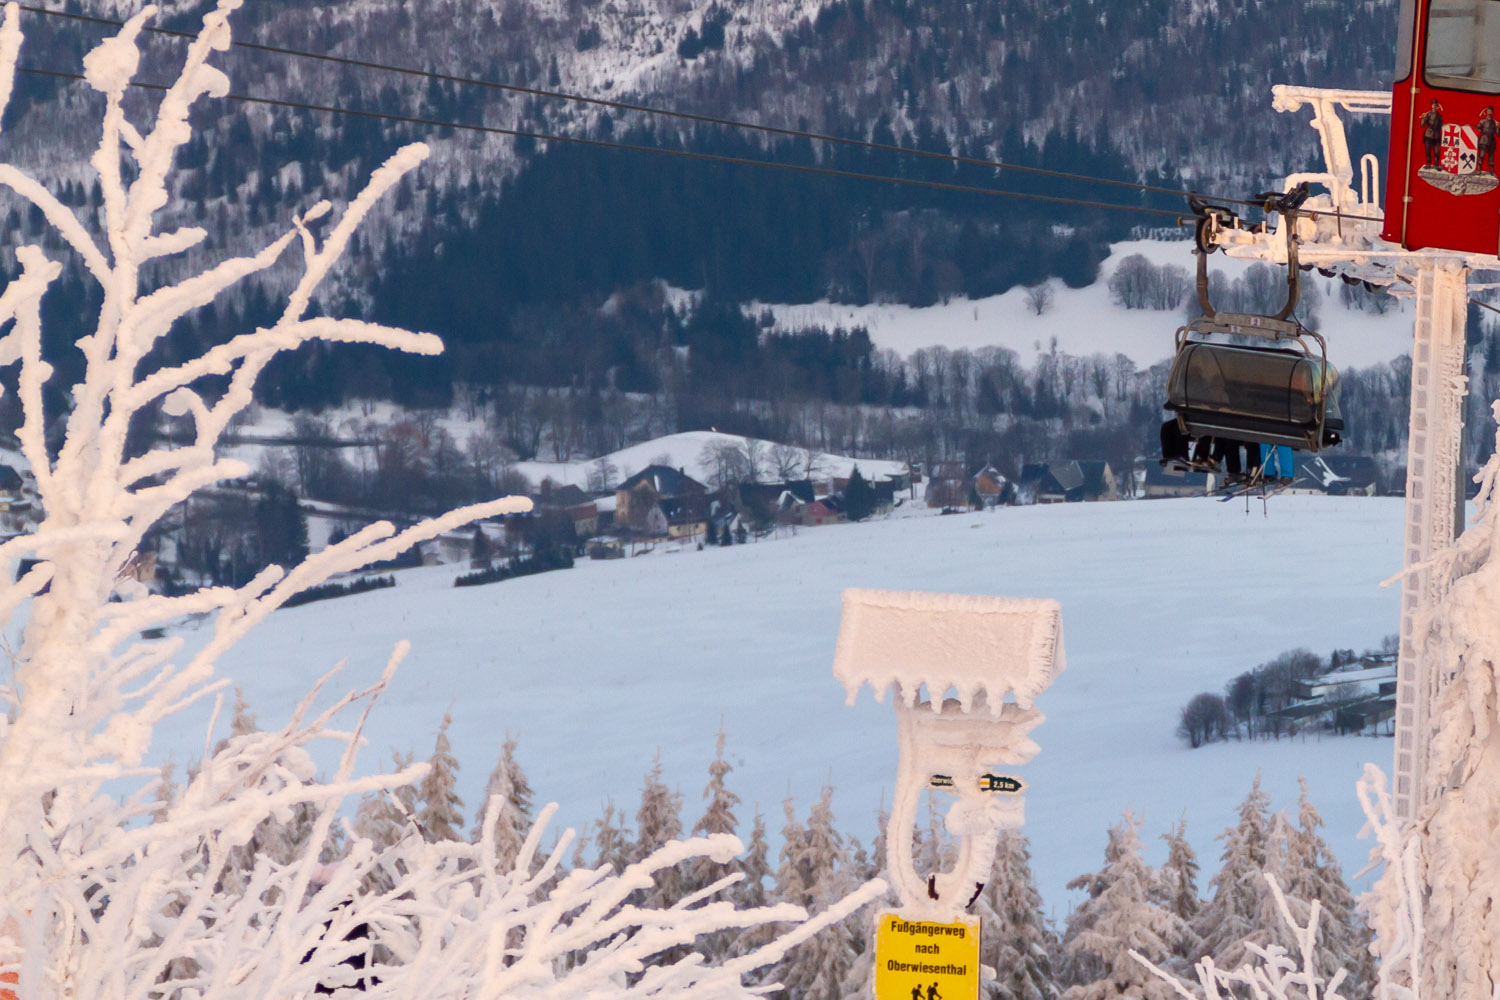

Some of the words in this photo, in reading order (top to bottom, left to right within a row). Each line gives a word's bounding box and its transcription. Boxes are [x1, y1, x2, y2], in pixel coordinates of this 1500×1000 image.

[1004, 781, 1015, 789] km
[891, 921, 965, 939] Fußgängerweg
[915, 943, 940, 954] nach
[887, 959, 967, 976] Oberwiesenthal
